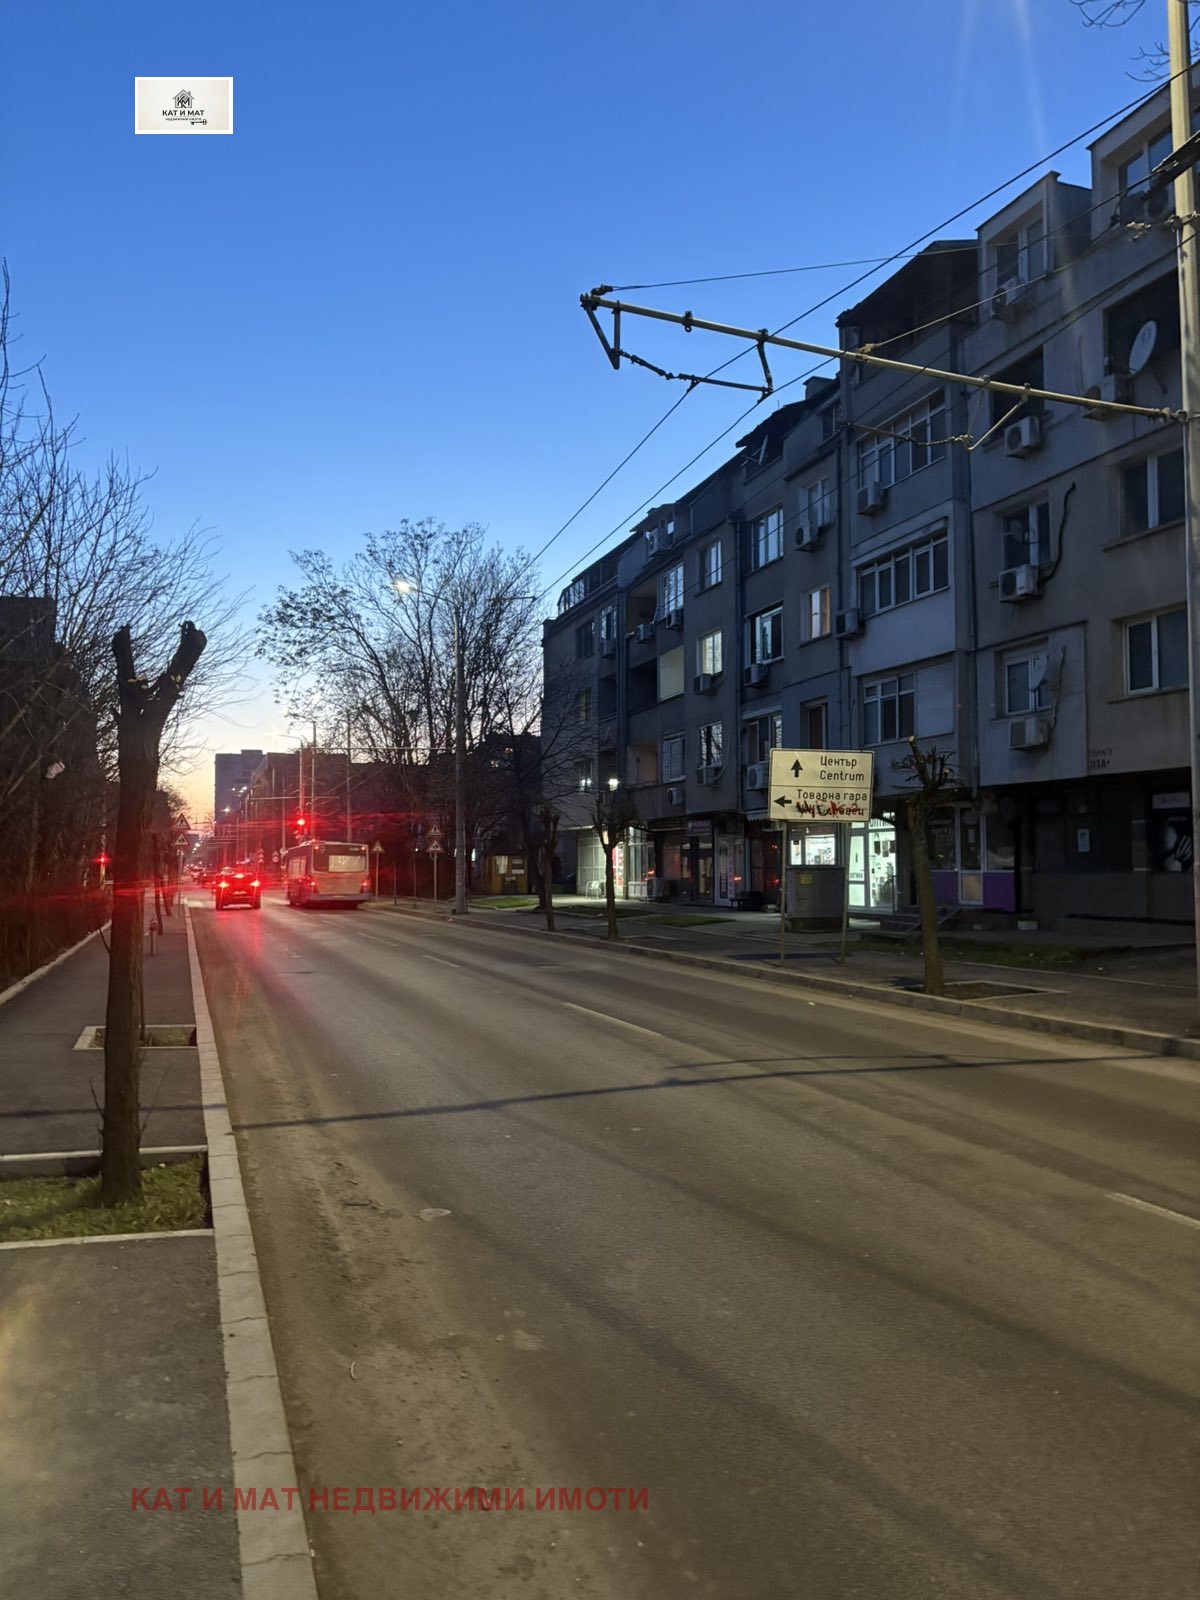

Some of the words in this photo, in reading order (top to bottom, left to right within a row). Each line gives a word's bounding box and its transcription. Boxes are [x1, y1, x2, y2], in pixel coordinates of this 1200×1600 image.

[820, 756, 858, 769] Център
[819, 770, 865, 781] Centrum
[797, 789, 840, 801] Товарна
[843, 792, 867, 803] гара
